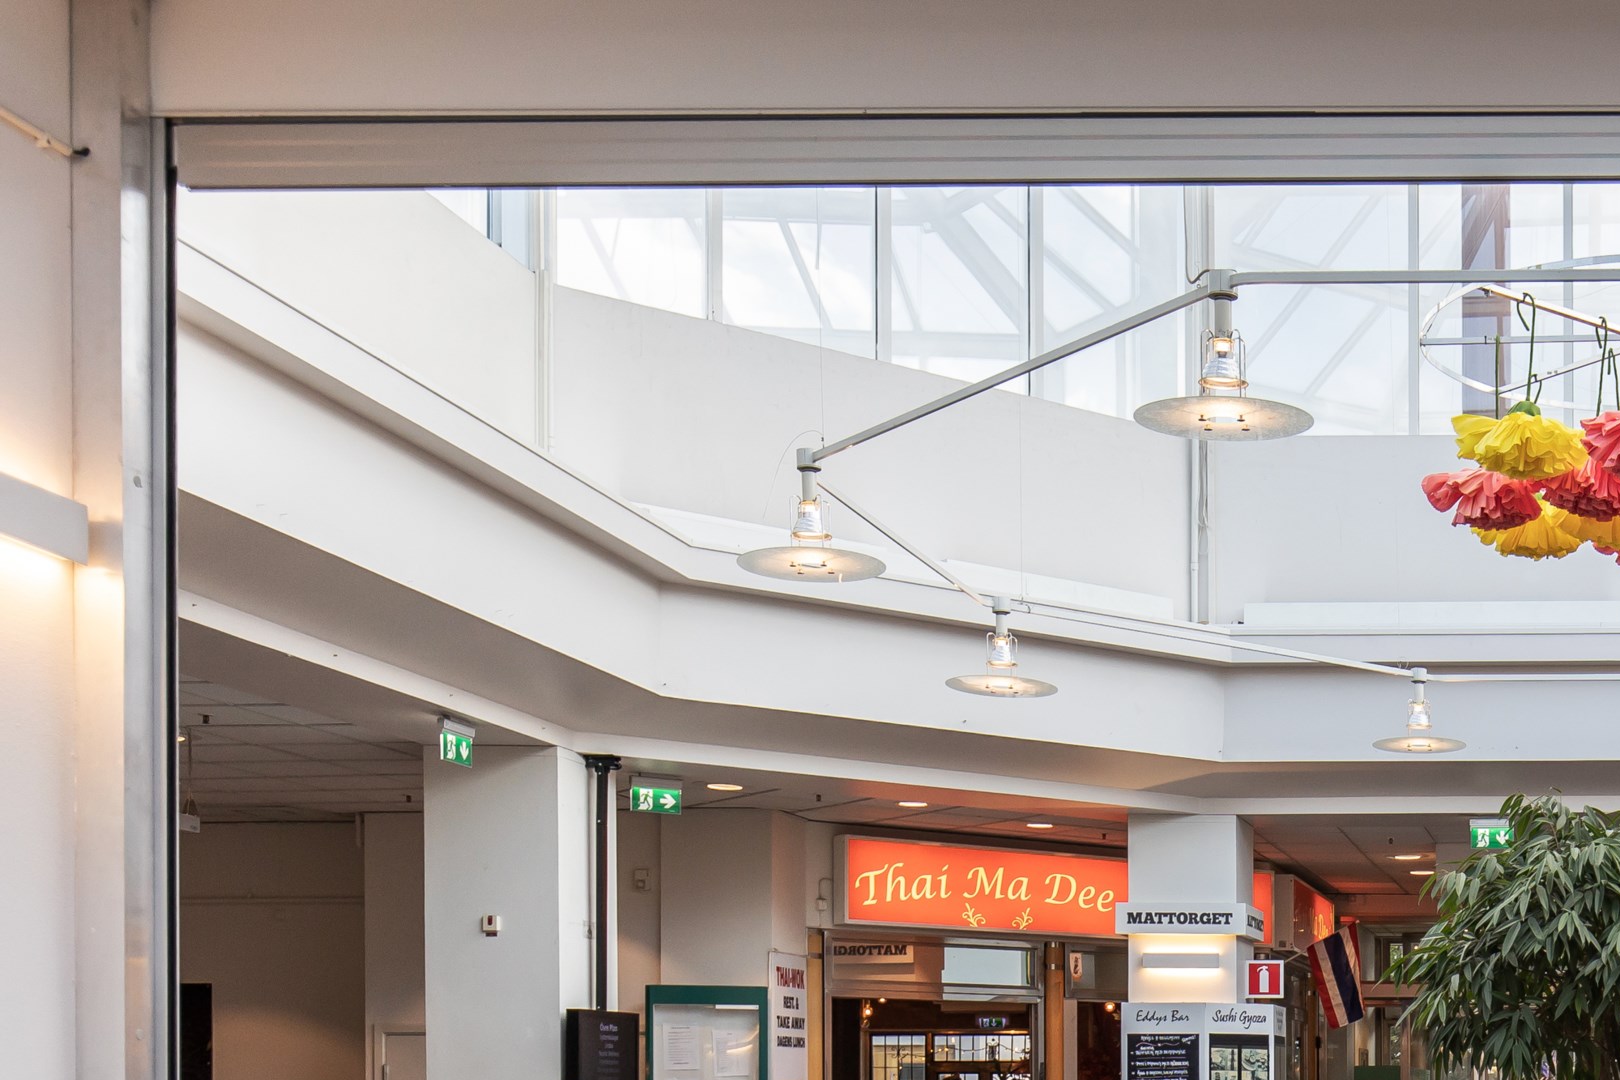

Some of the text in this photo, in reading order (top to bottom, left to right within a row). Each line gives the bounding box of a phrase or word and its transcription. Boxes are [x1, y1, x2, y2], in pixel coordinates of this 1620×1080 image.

[855, 862, 1114, 913] Thai Ma Dee
[1126, 911, 1233, 926] MATTORGET
[777, 1015, 805, 1030] TAKE AWAY
[1136, 1009, 1190, 1026] Eddys Bar
[1212, 1008, 1237, 1023] Sushi
[1239, 1011, 1267, 1029] Gyoza
